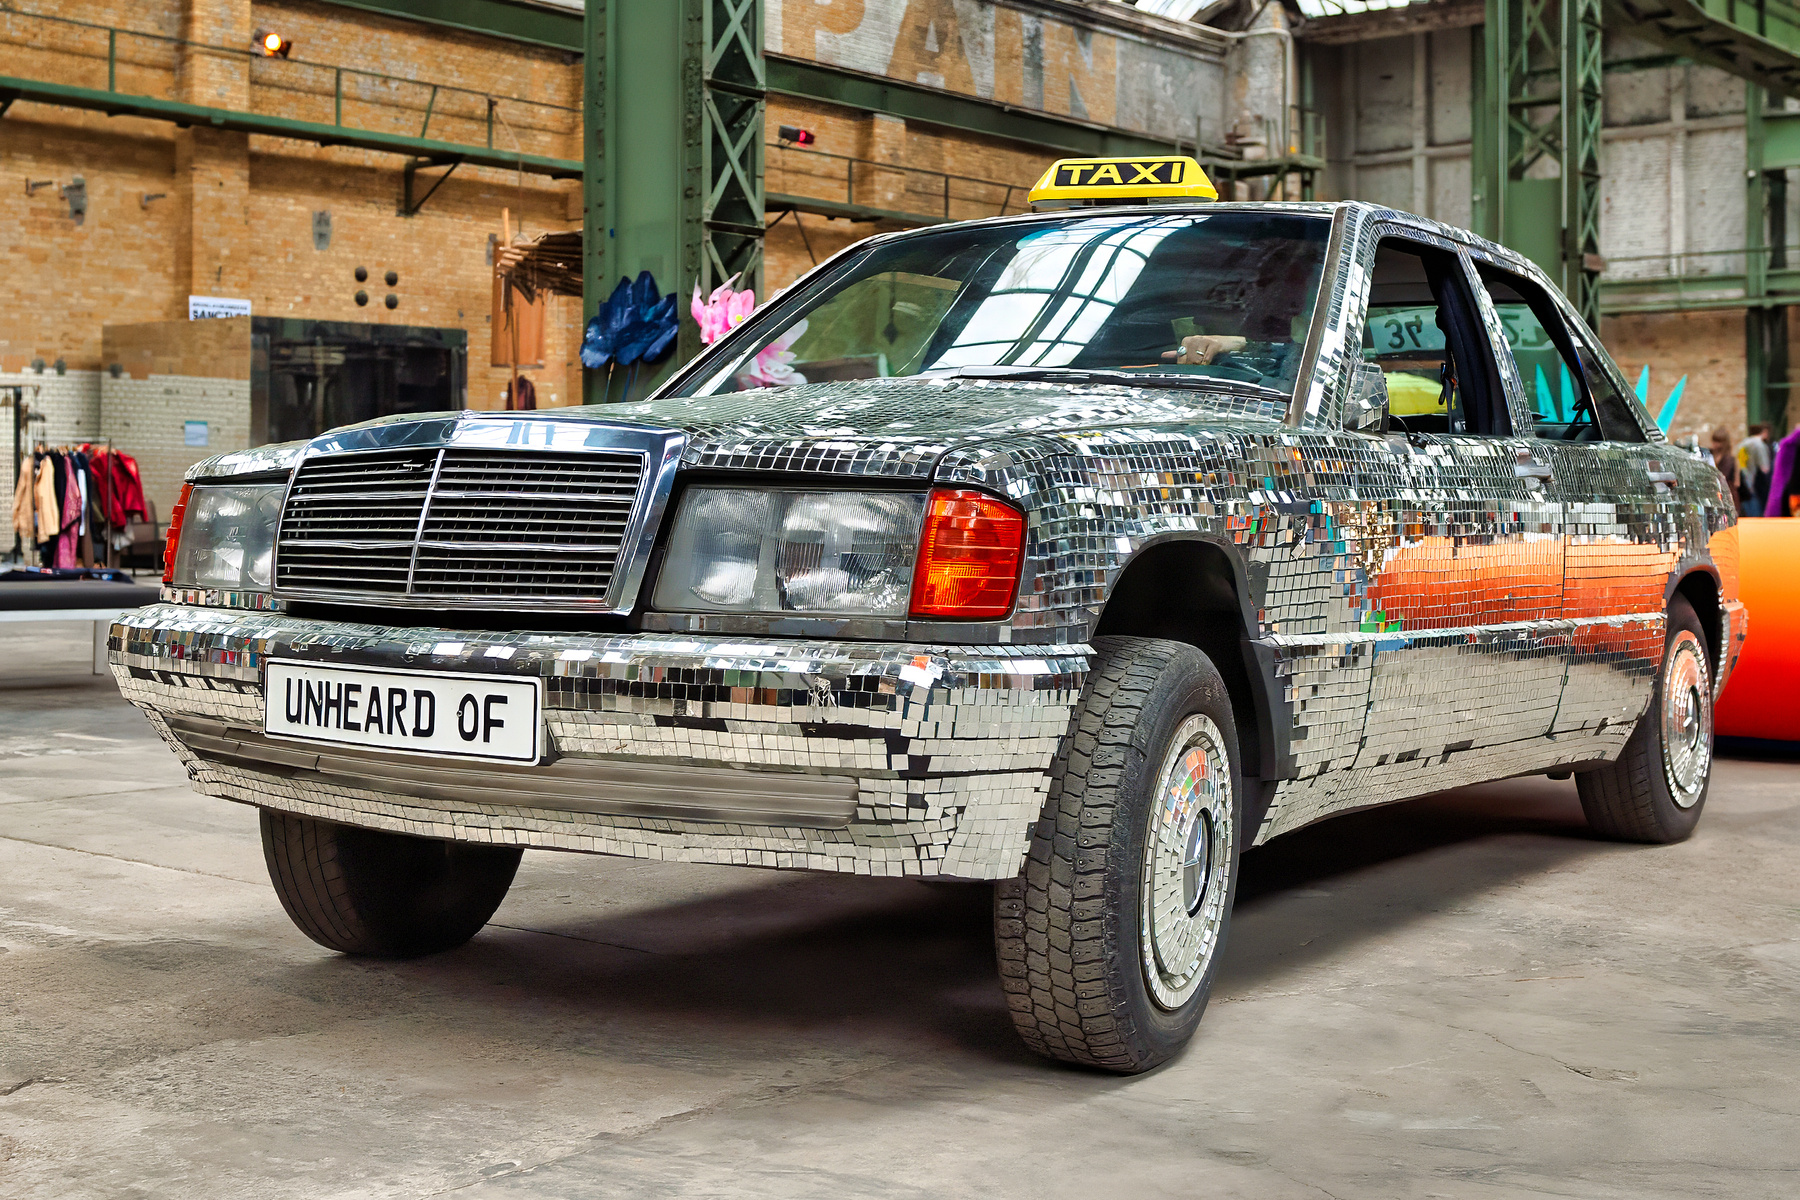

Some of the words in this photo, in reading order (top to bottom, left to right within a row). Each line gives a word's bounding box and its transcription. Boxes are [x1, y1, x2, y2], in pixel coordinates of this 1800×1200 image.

[1061, 162, 1182, 185] TAXI
[286, 677, 435, 738] UNHEARD
[458, 692, 508, 743] OF
